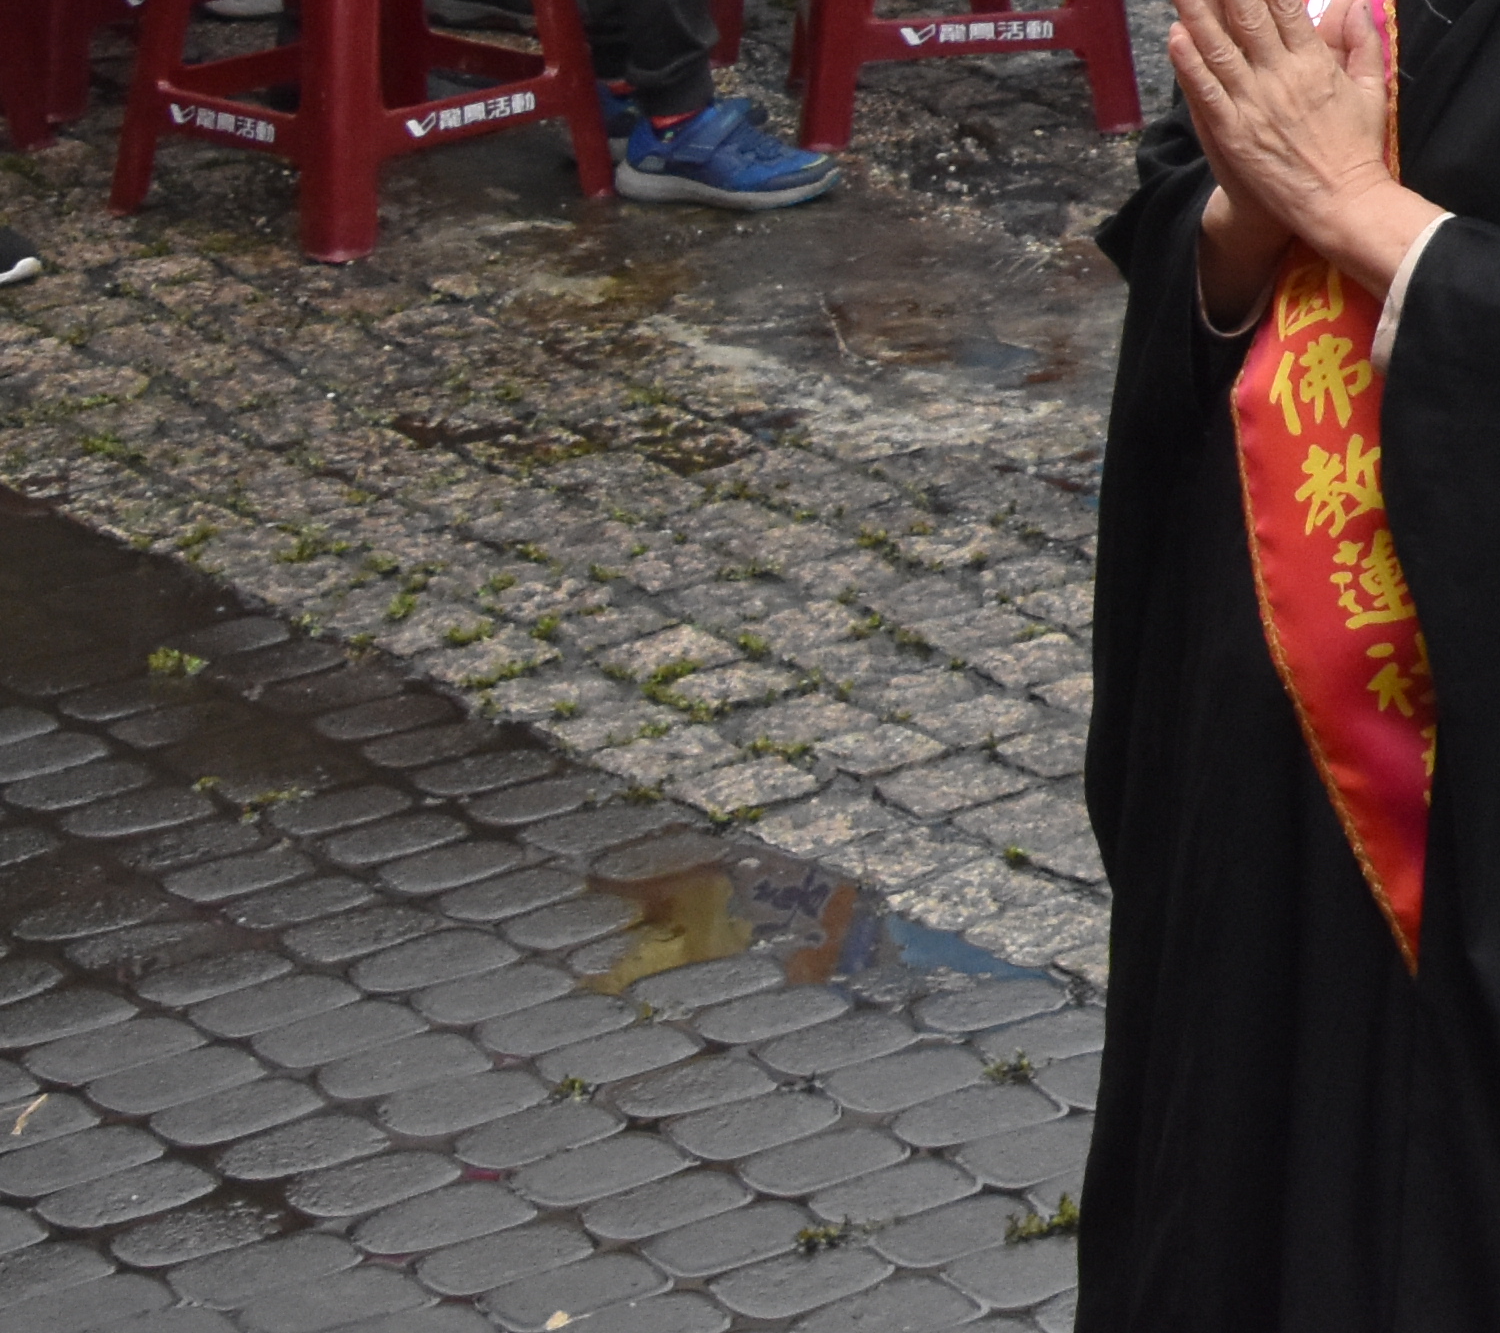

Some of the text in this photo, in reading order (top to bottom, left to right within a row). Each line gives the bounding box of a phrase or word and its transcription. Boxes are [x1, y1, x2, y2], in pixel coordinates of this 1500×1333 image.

[939, 20, 1054, 44] 龍鳳活動
[196, 106, 275, 144] 龍鳳活動
[439, 91, 536, 131] 龍鳳活動
